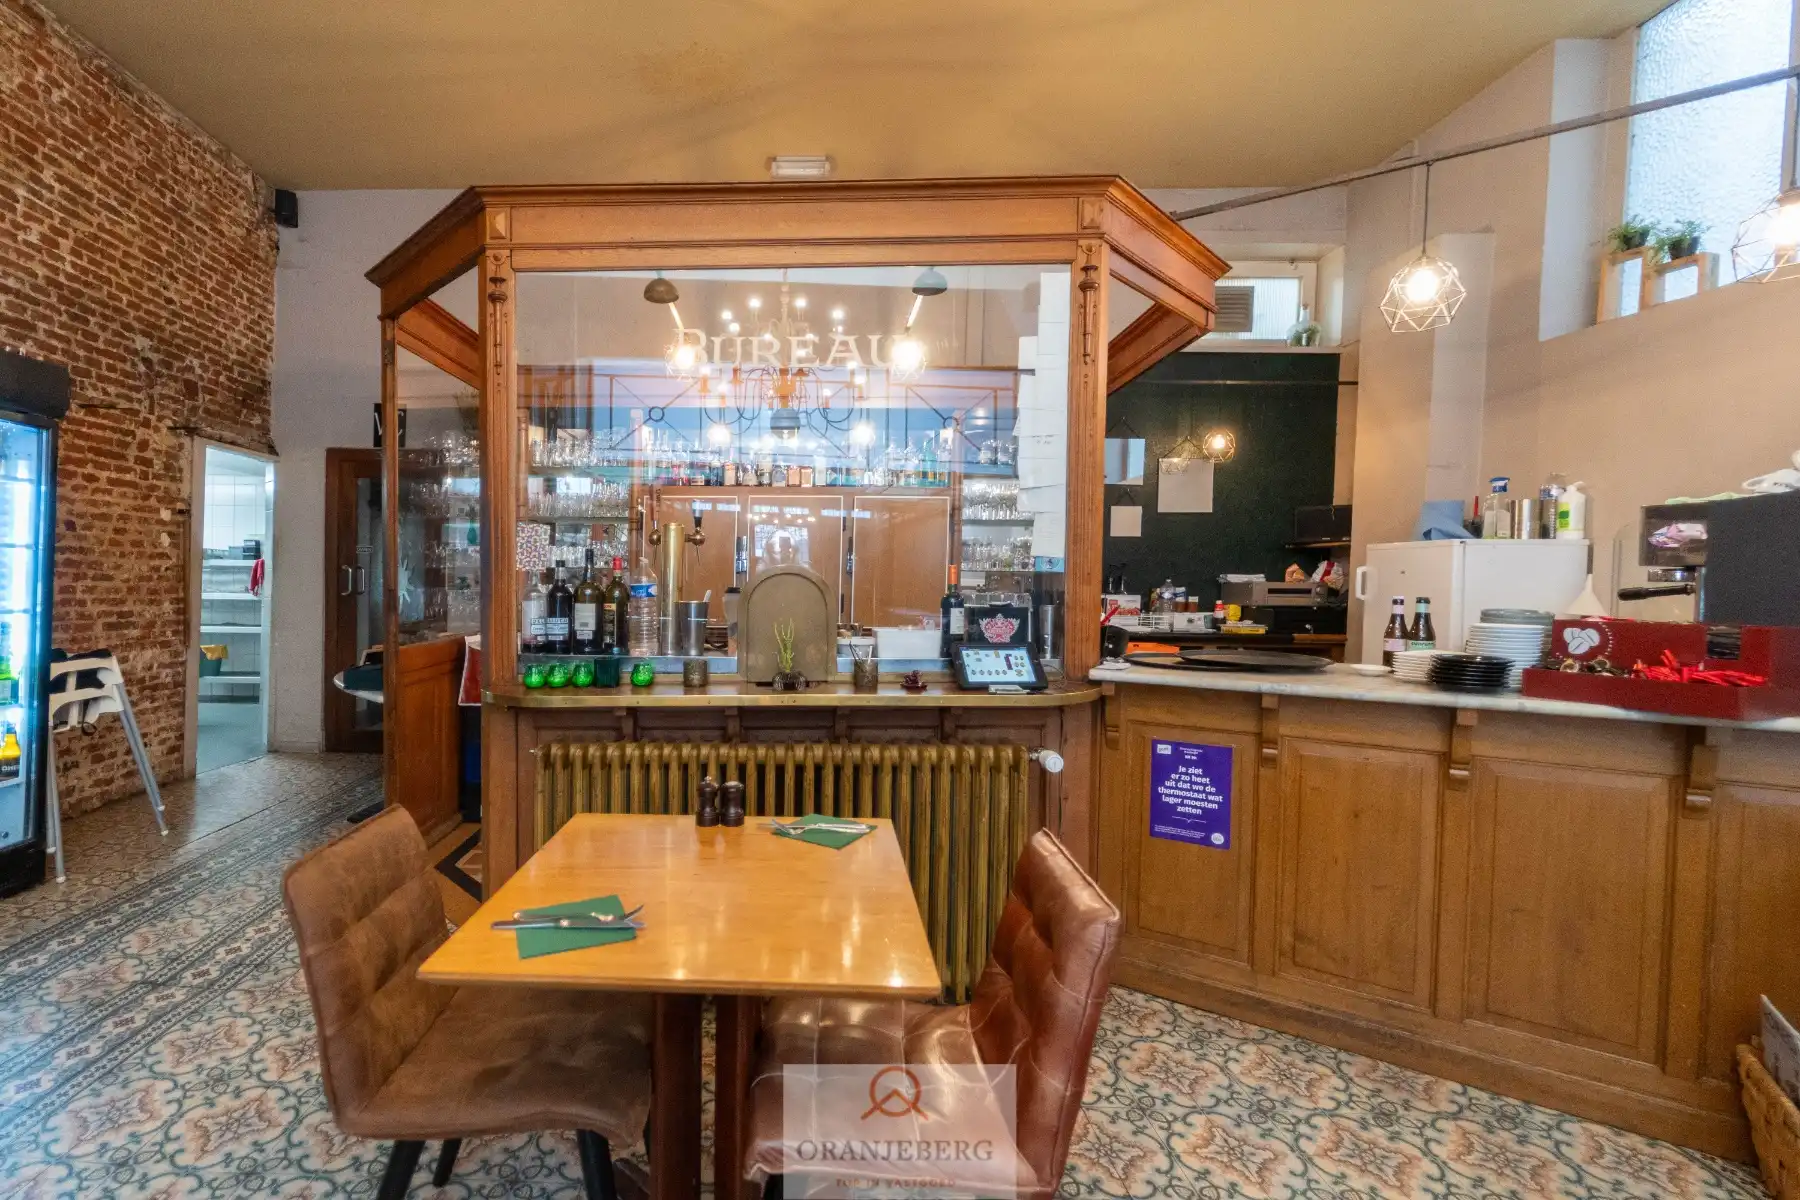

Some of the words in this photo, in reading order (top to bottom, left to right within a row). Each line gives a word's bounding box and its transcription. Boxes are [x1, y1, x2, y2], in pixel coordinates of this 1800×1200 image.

[672, 328, 909, 368] BUREAU
[1188, 767, 1203, 775] ziet
[1165, 779, 1176, 787] uit
[1177, 781, 1190, 789] dat
[1205, 785, 1216, 793] de
[1191, 775, 1210, 784] heet
[1158, 786, 1206, 800] thermostaat
[1162, 794, 1182, 804] lager
[1183, 799, 1218, 810] moesten
[1177, 806, 1202, 815] zetten
